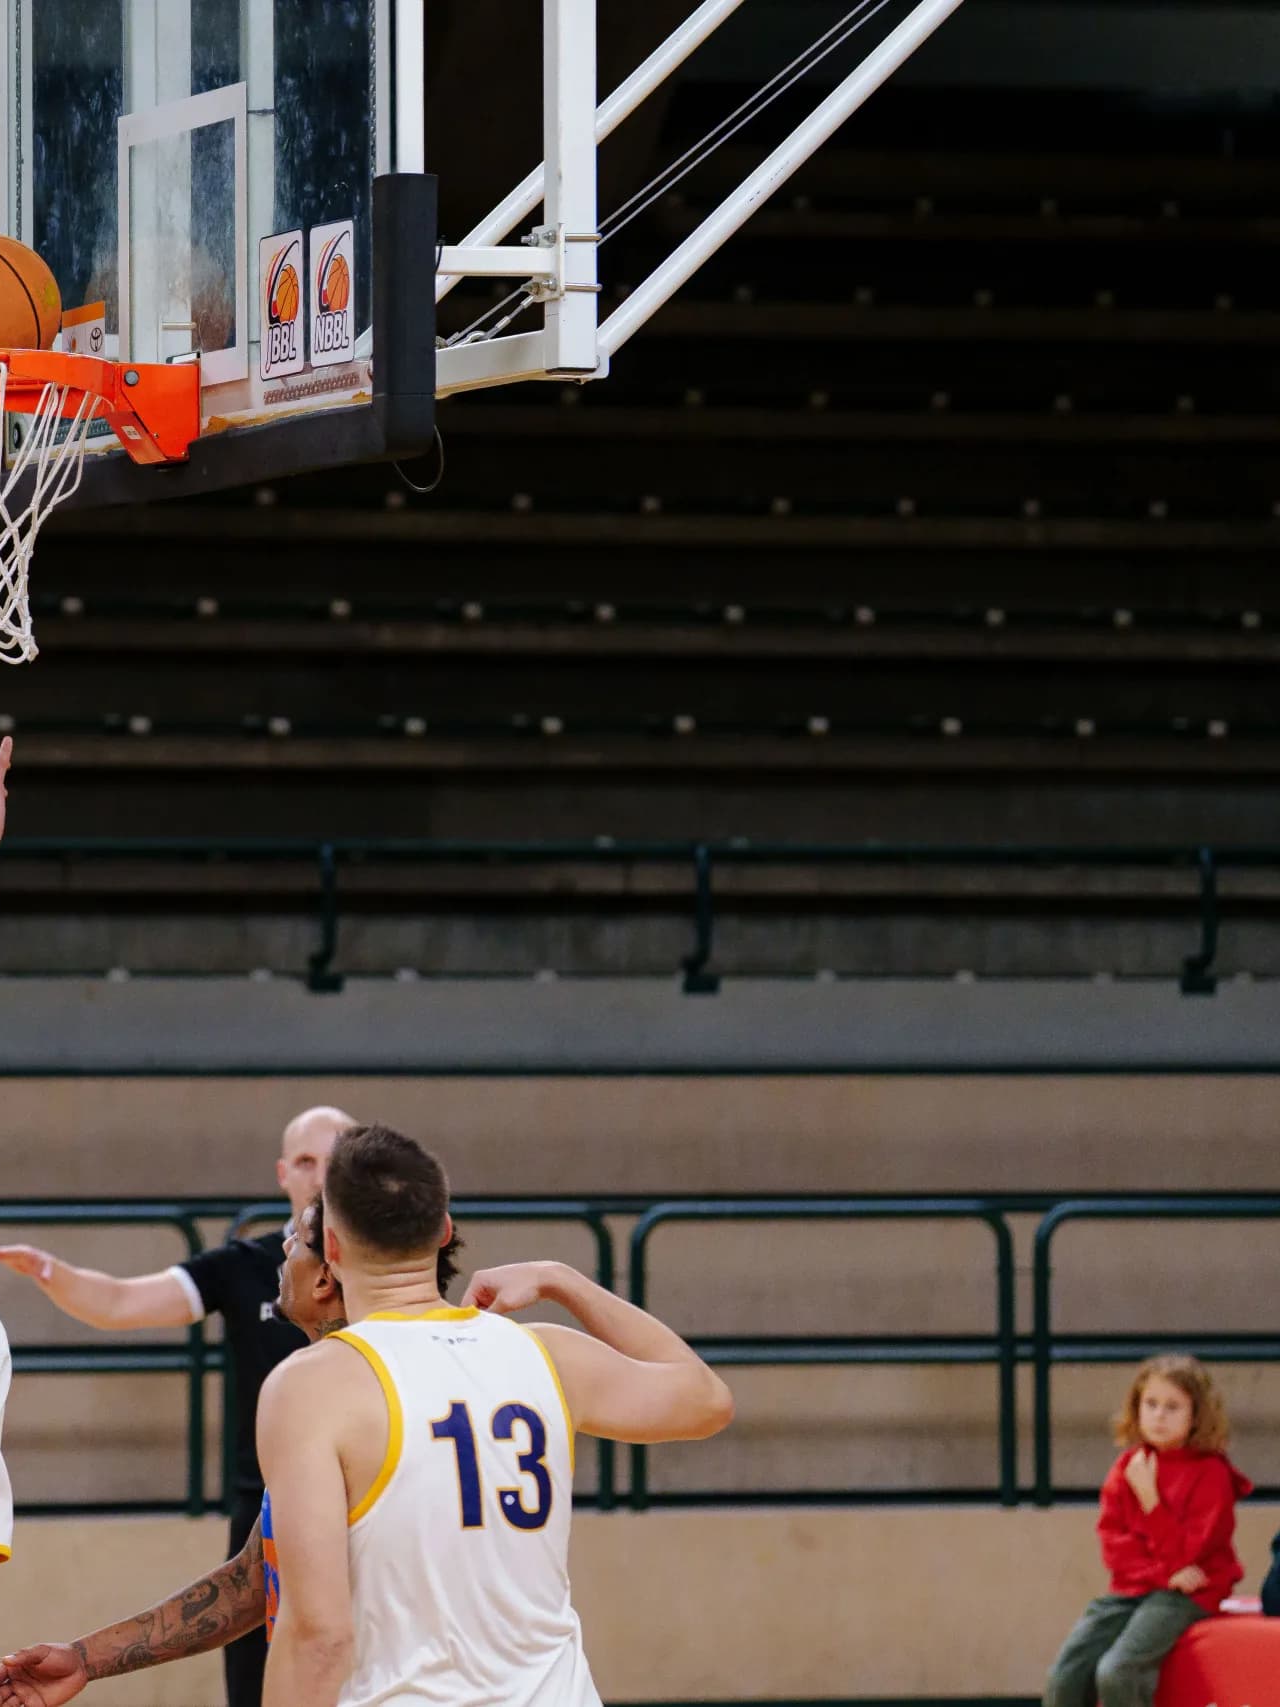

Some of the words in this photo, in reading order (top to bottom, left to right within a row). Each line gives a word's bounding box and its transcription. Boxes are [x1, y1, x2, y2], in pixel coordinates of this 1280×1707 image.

[265, 322, 297, 373] JBBL
[314, 311, 350, 353] NBBL
[431, 1400, 553, 1530] 13
